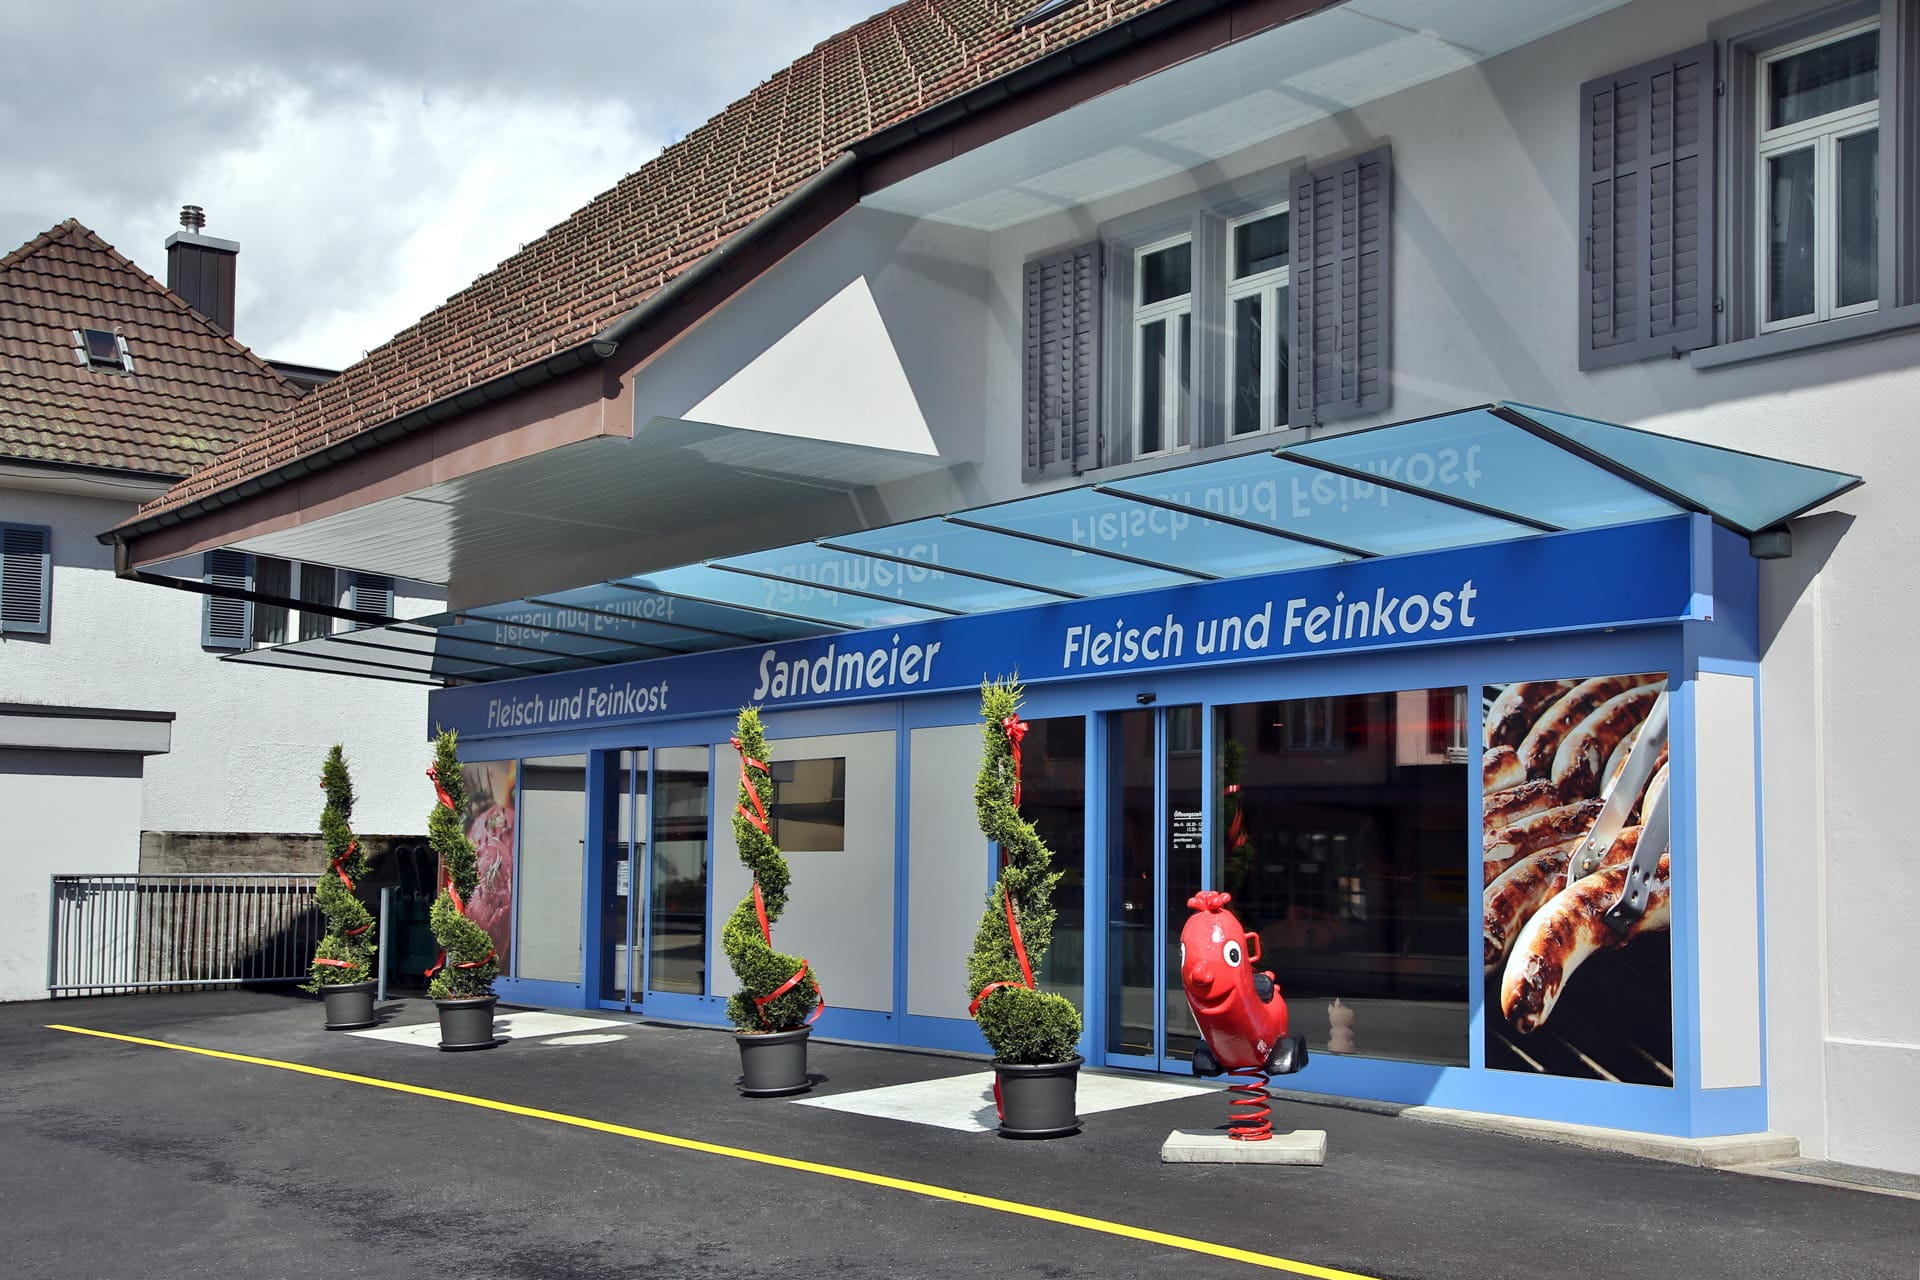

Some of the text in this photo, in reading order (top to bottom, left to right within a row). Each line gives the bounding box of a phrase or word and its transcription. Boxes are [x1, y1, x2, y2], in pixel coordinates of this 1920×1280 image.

[1062, 579, 1478, 669] Fleisch und Feinkost
[752, 633, 942, 701] Sandmeier
[487, 679, 669, 730] Fleisch und Feinkost
